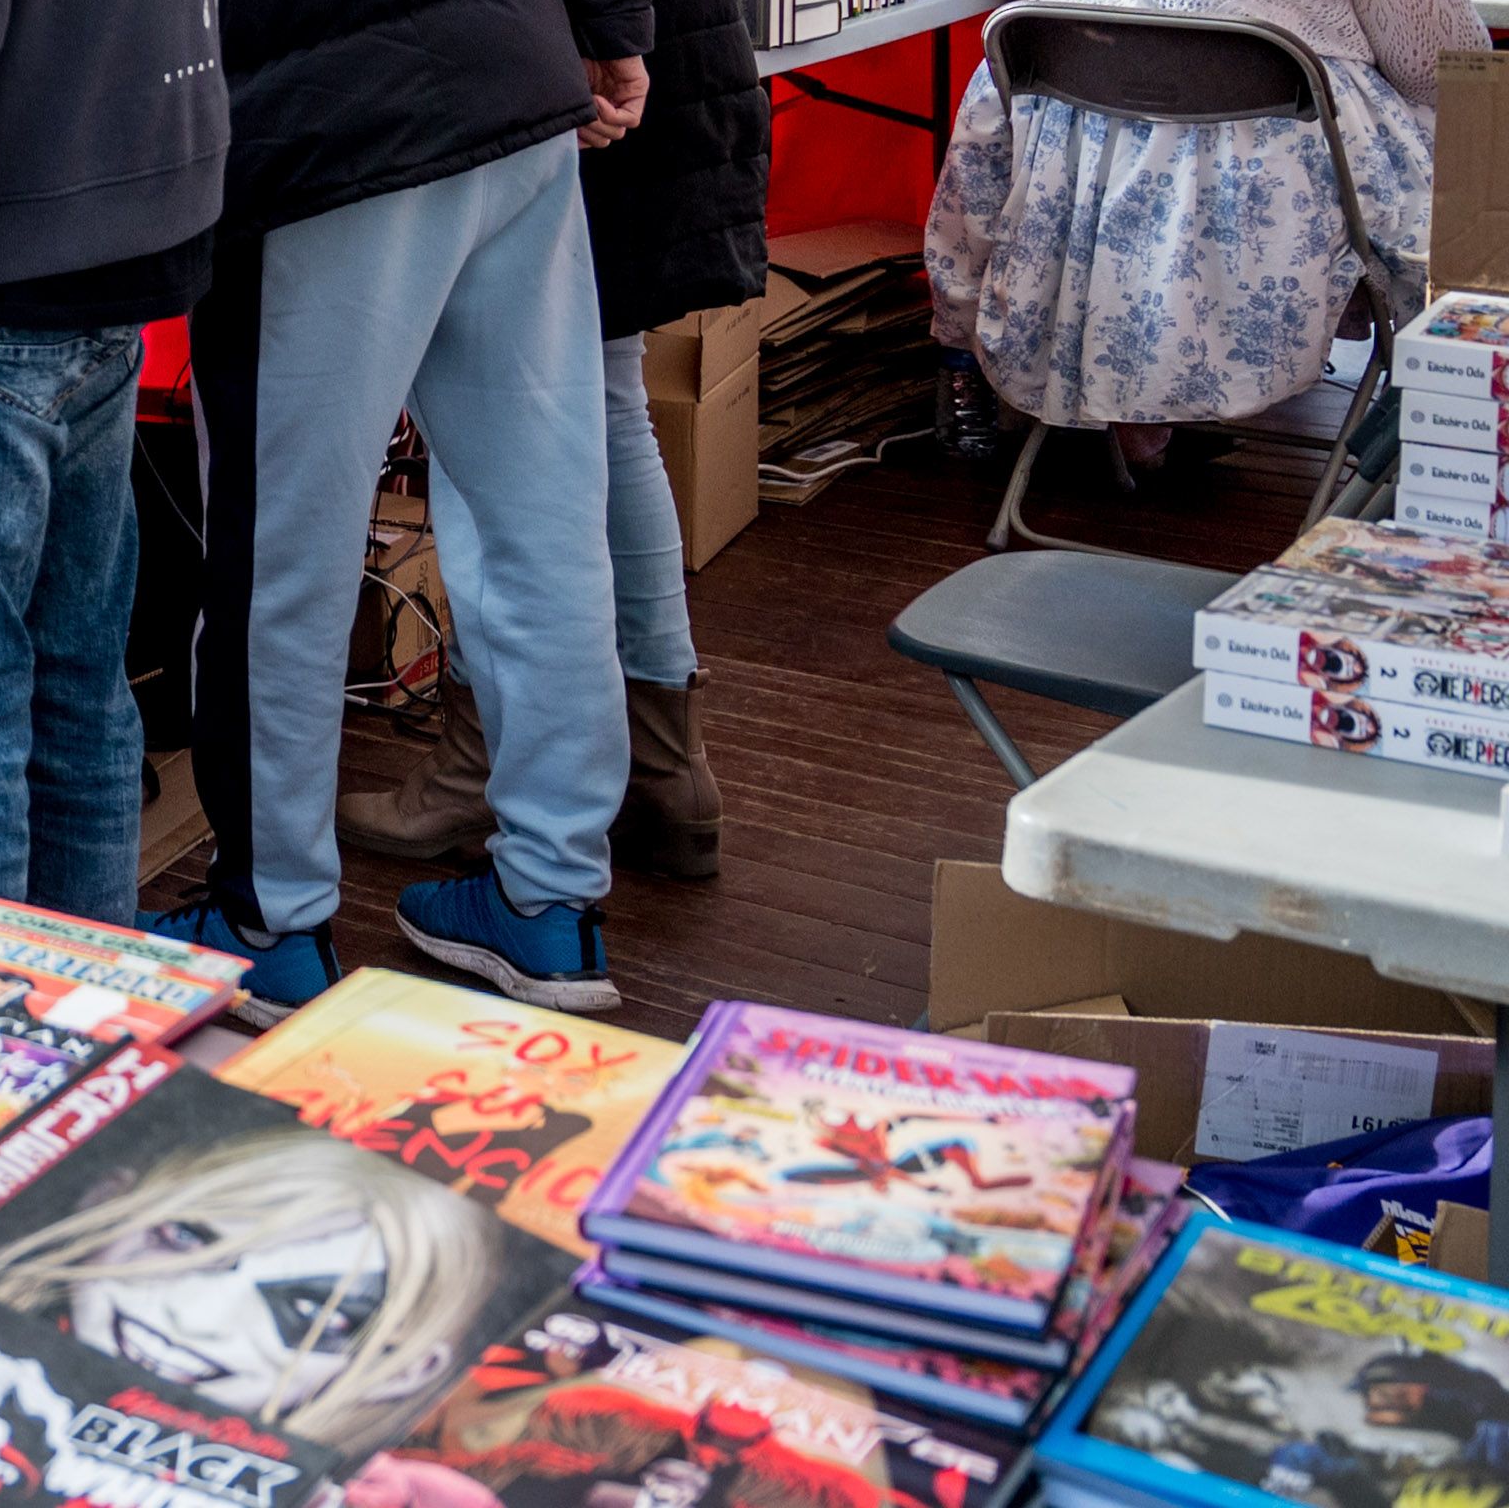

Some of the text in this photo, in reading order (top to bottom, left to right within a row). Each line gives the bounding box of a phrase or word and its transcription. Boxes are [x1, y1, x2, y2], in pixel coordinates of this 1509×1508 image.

[1465, 366, 1486, 381] Oda
[1470, 419, 1492, 433] Oda
[1470, 471, 1491, 486] Oda
[1463, 516, 1484, 532] Oda
[1268, 645, 1291, 663] Oda
[1380, 667, 1397, 680] 2
[1414, 670, 1459, 700] ONE
[1281, 703, 1304, 723] Oda
[1392, 727, 1411, 740] 2
[93, 930, 194, 966] GROUP
[460, 1018, 640, 1087] SOY
[67, 1402, 301, 1506] BLACK
